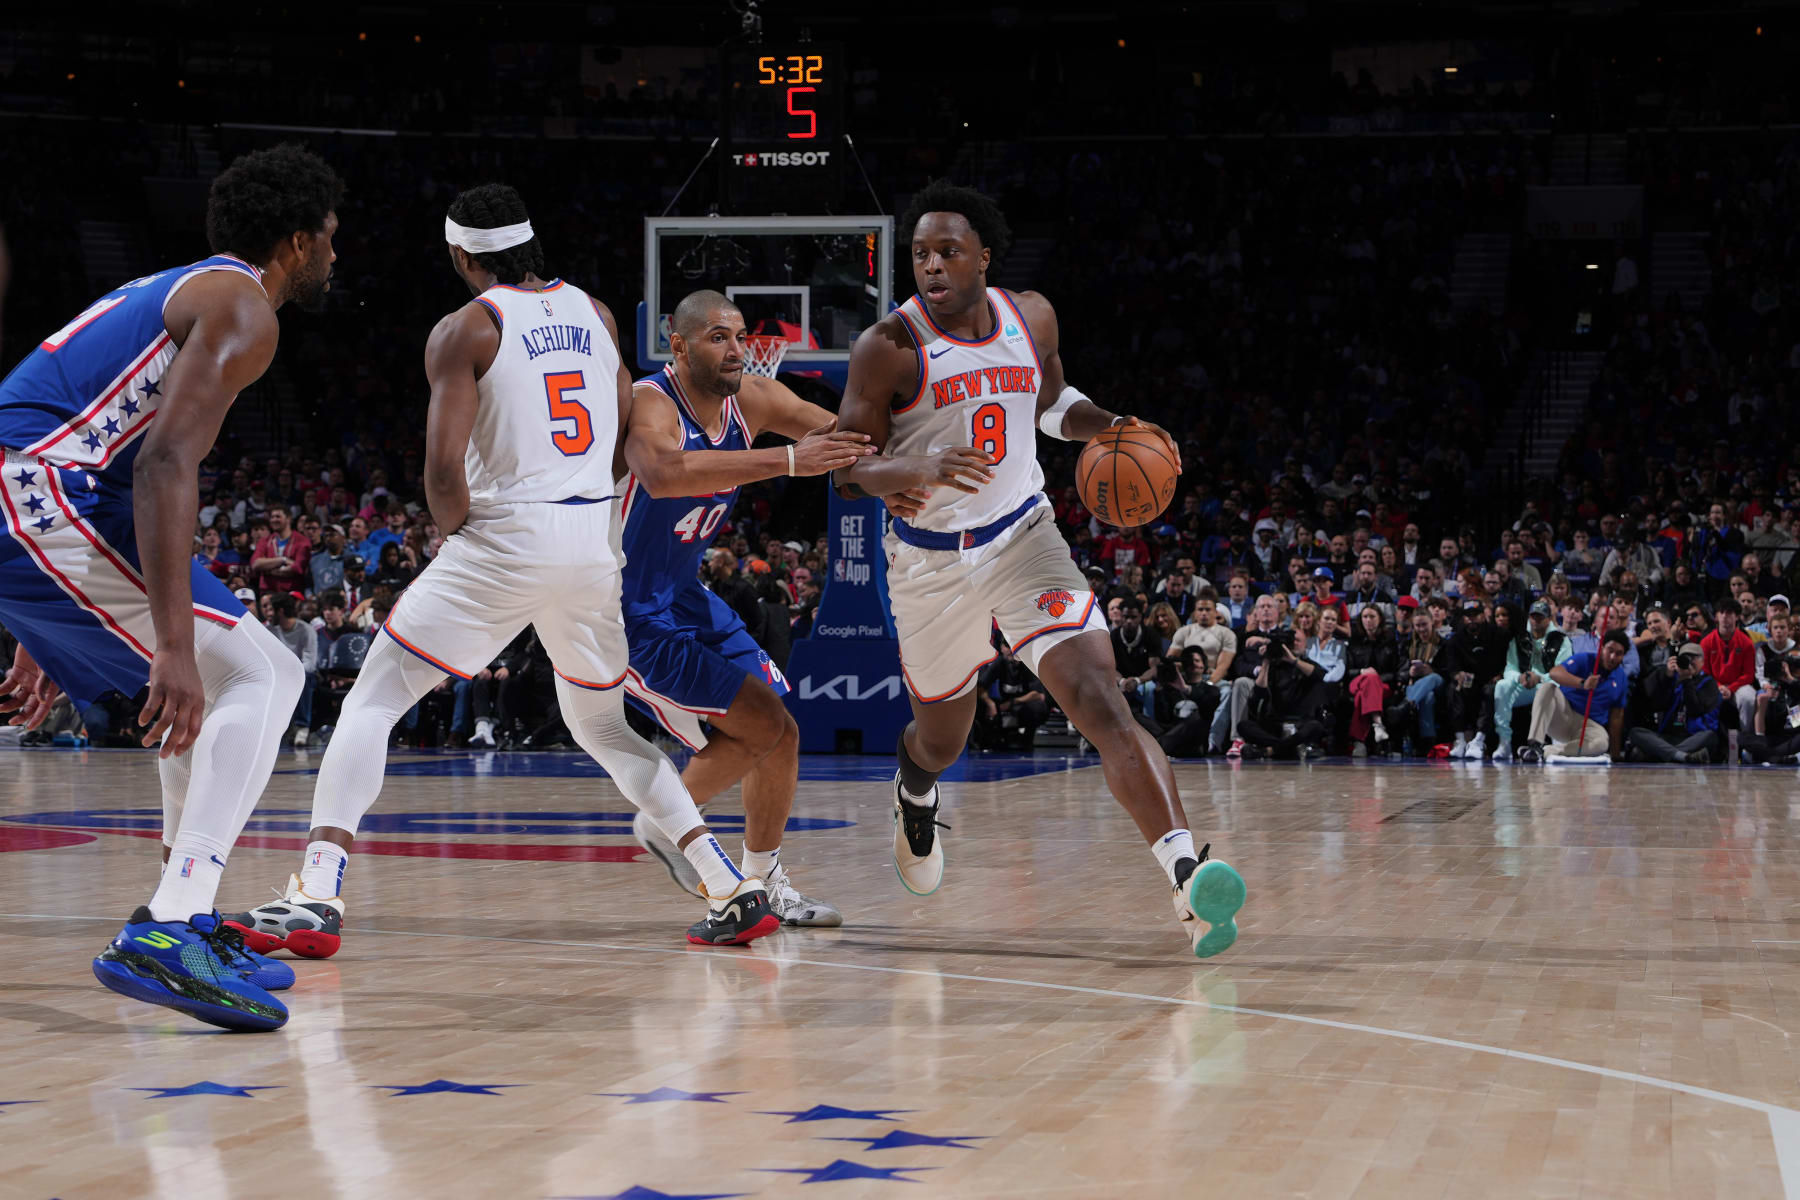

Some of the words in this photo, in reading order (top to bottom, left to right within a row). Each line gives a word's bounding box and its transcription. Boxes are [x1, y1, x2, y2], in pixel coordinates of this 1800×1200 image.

[759, 56, 823, 84] 5:32
[787, 87, 816, 138] 5
[759, 152, 830, 166] TISSOT
[521, 325, 592, 360] ACHIUWA
[932, 369, 982, 409] NEW
[983, 366, 1036, 394] YORK
[543, 370, 595, 457] 5
[972, 402, 1007, 466] 8
[674, 503, 728, 543] 40
[840, 515, 865, 536] GET
[840, 537, 865, 558] THE
[845, 559, 870, 586] App
[818, 625, 857, 638] Google
[858, 625, 883, 636] Pixel
[799, 674, 901, 700] KIA
